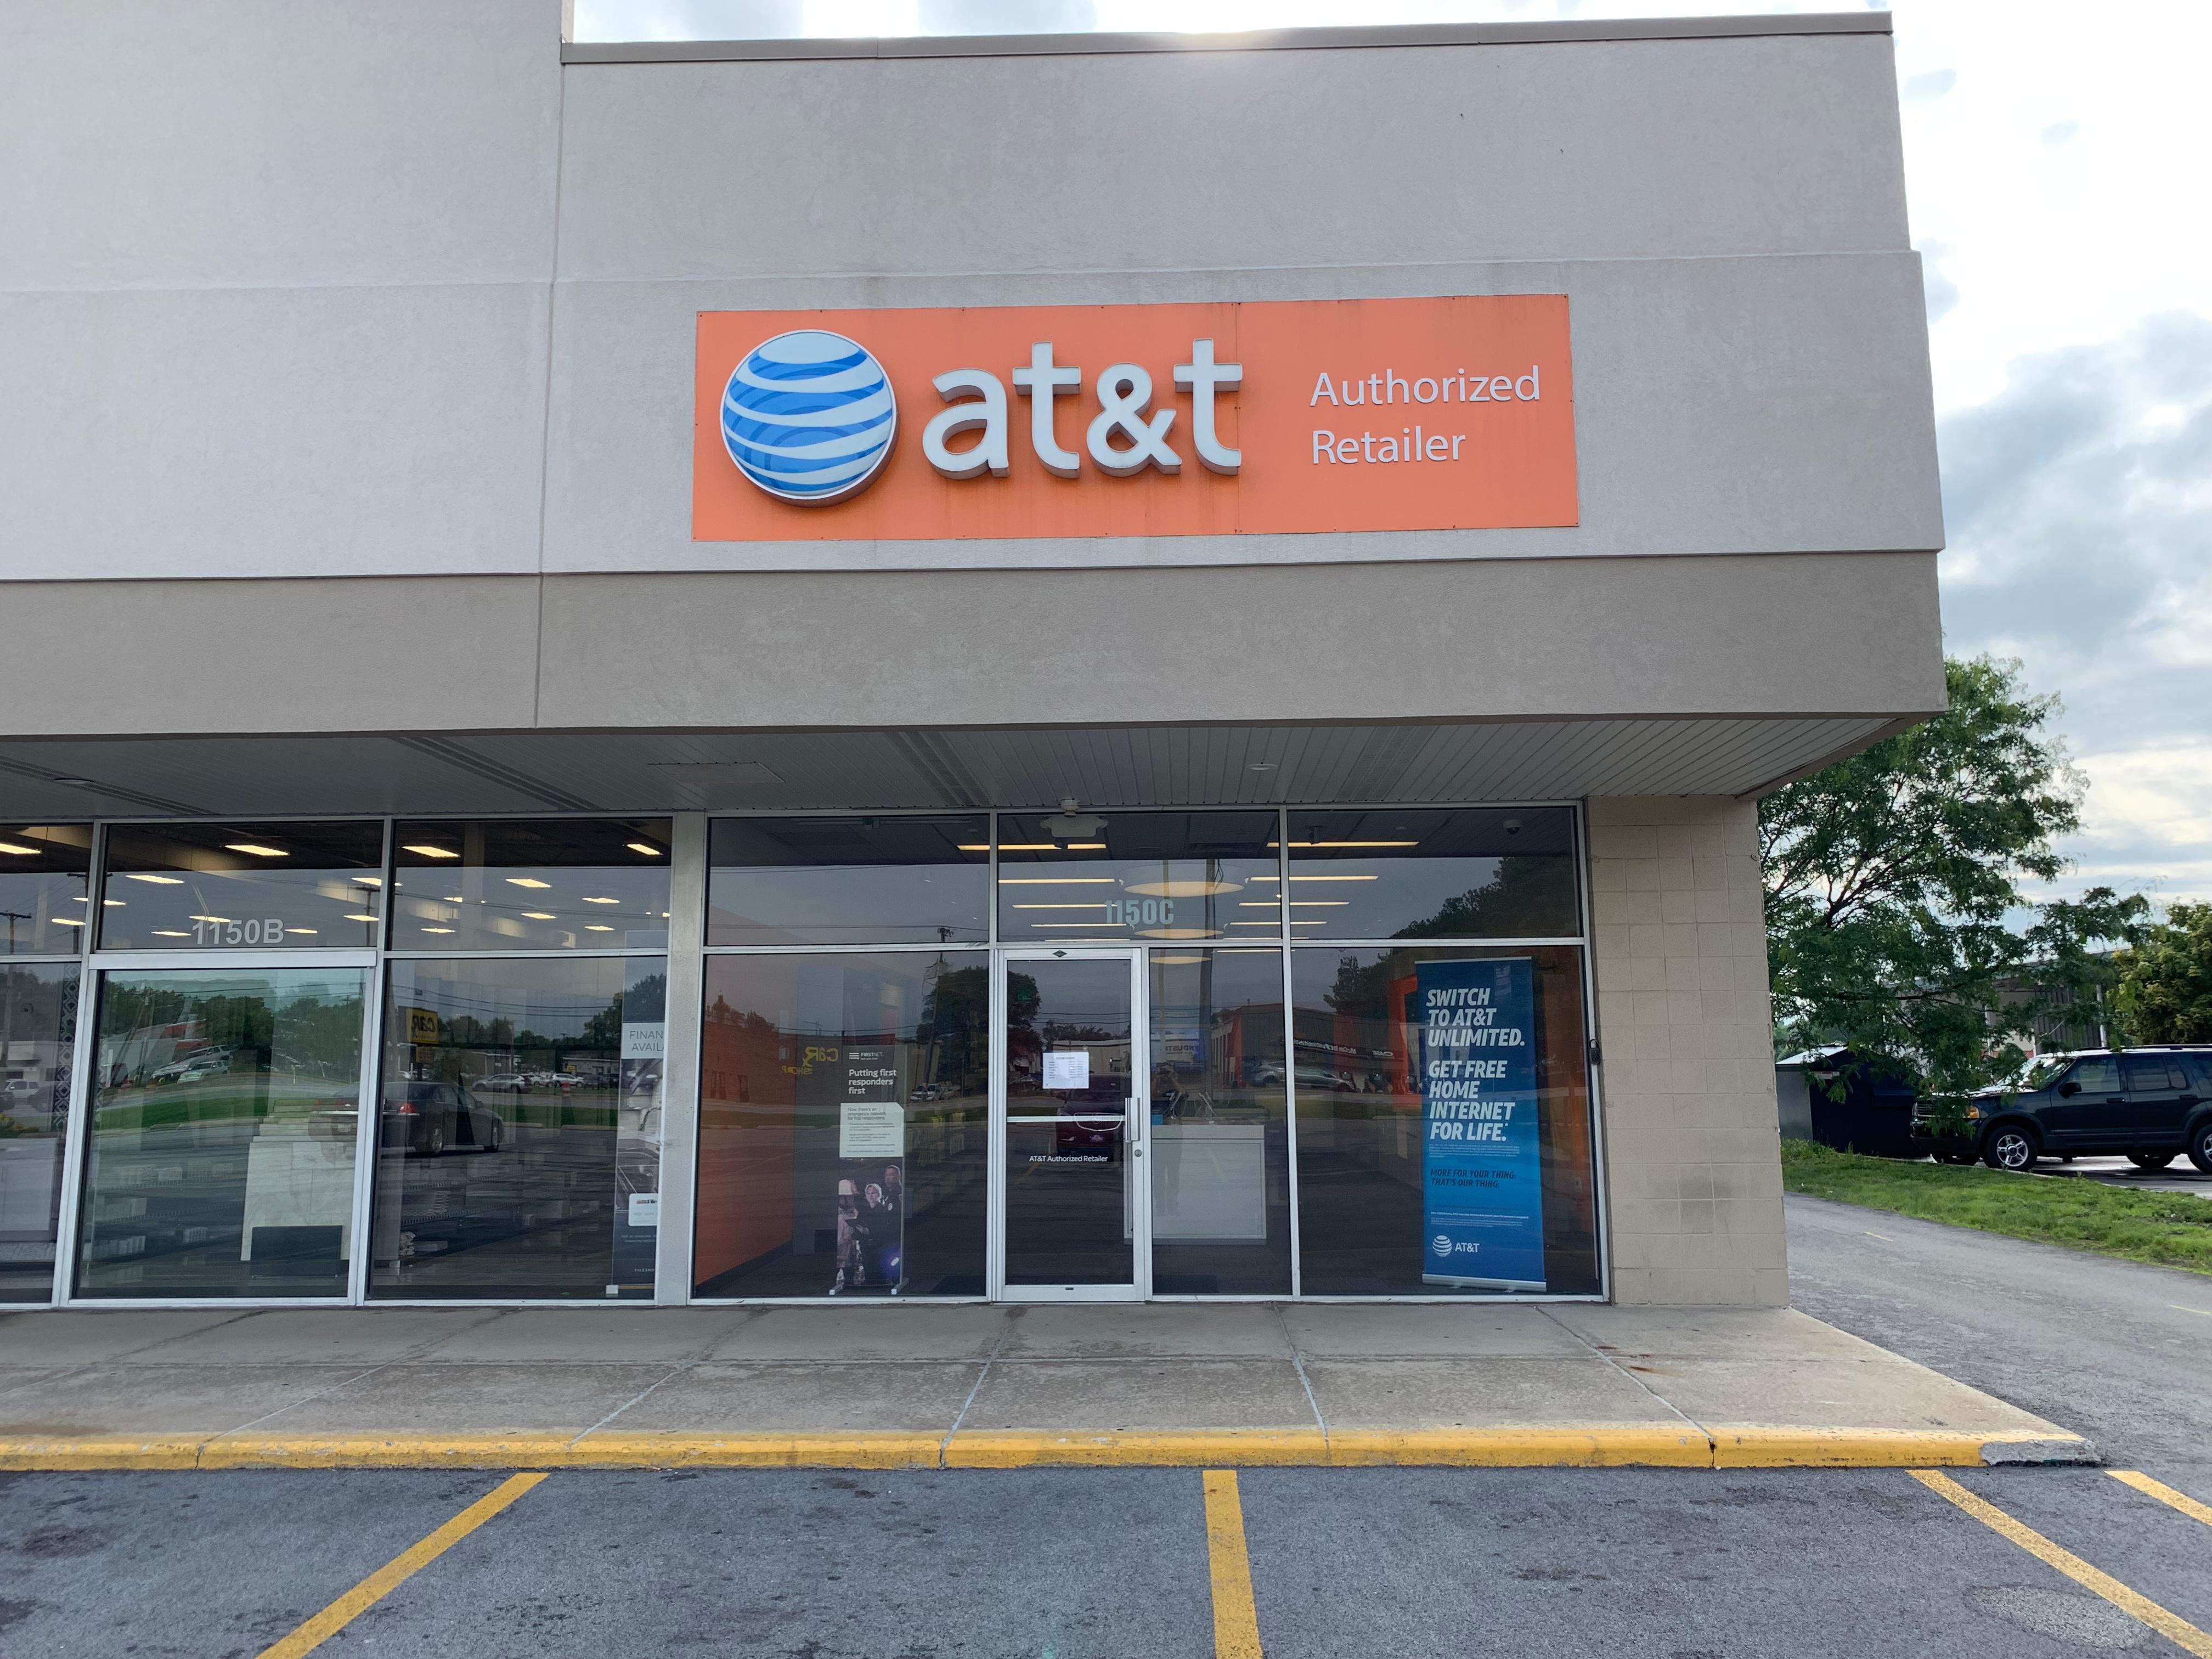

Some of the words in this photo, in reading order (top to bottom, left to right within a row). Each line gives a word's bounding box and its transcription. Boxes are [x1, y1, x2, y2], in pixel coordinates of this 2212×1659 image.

[1310, 365, 1540, 407] Authorized
[922, 338, 1243, 479] at&t
[1312, 425, 1466, 464] Retailer
[1104, 899, 1174, 925] 1150C
[192, 918, 285, 945] 1150B
[1426, 988, 1491, 1007] SWITCH
[1428, 1009, 1450, 1026] TO
[1452, 1008, 1497, 1026] AT&T
[1427, 1028, 1525, 1047] UNLIMITED.
[849, 1069, 878, 1077] Putting
[1429, 1060, 1463, 1079] GET
[1464, 1060, 1508, 1079] FREE
[848, 1077, 894, 1086] responders
[1429, 1081, 1480, 1099] HOME
[1429, 1101, 1516, 1120] INTERNET
[1430, 1121, 1463, 1140] FOR
[1430, 1169, 1452, 1177] MORE
[1453, 1169, 1468, 1177] FOR
[1470, 1170, 1489, 1178] YOUR
[1492, 1170, 1516, 1179] THING.
[1431, 1178, 1456, 1186] THAT'S
[1476, 1180, 1500, 1188] THING.
[1454, 1242, 1480, 1252] AT&T
